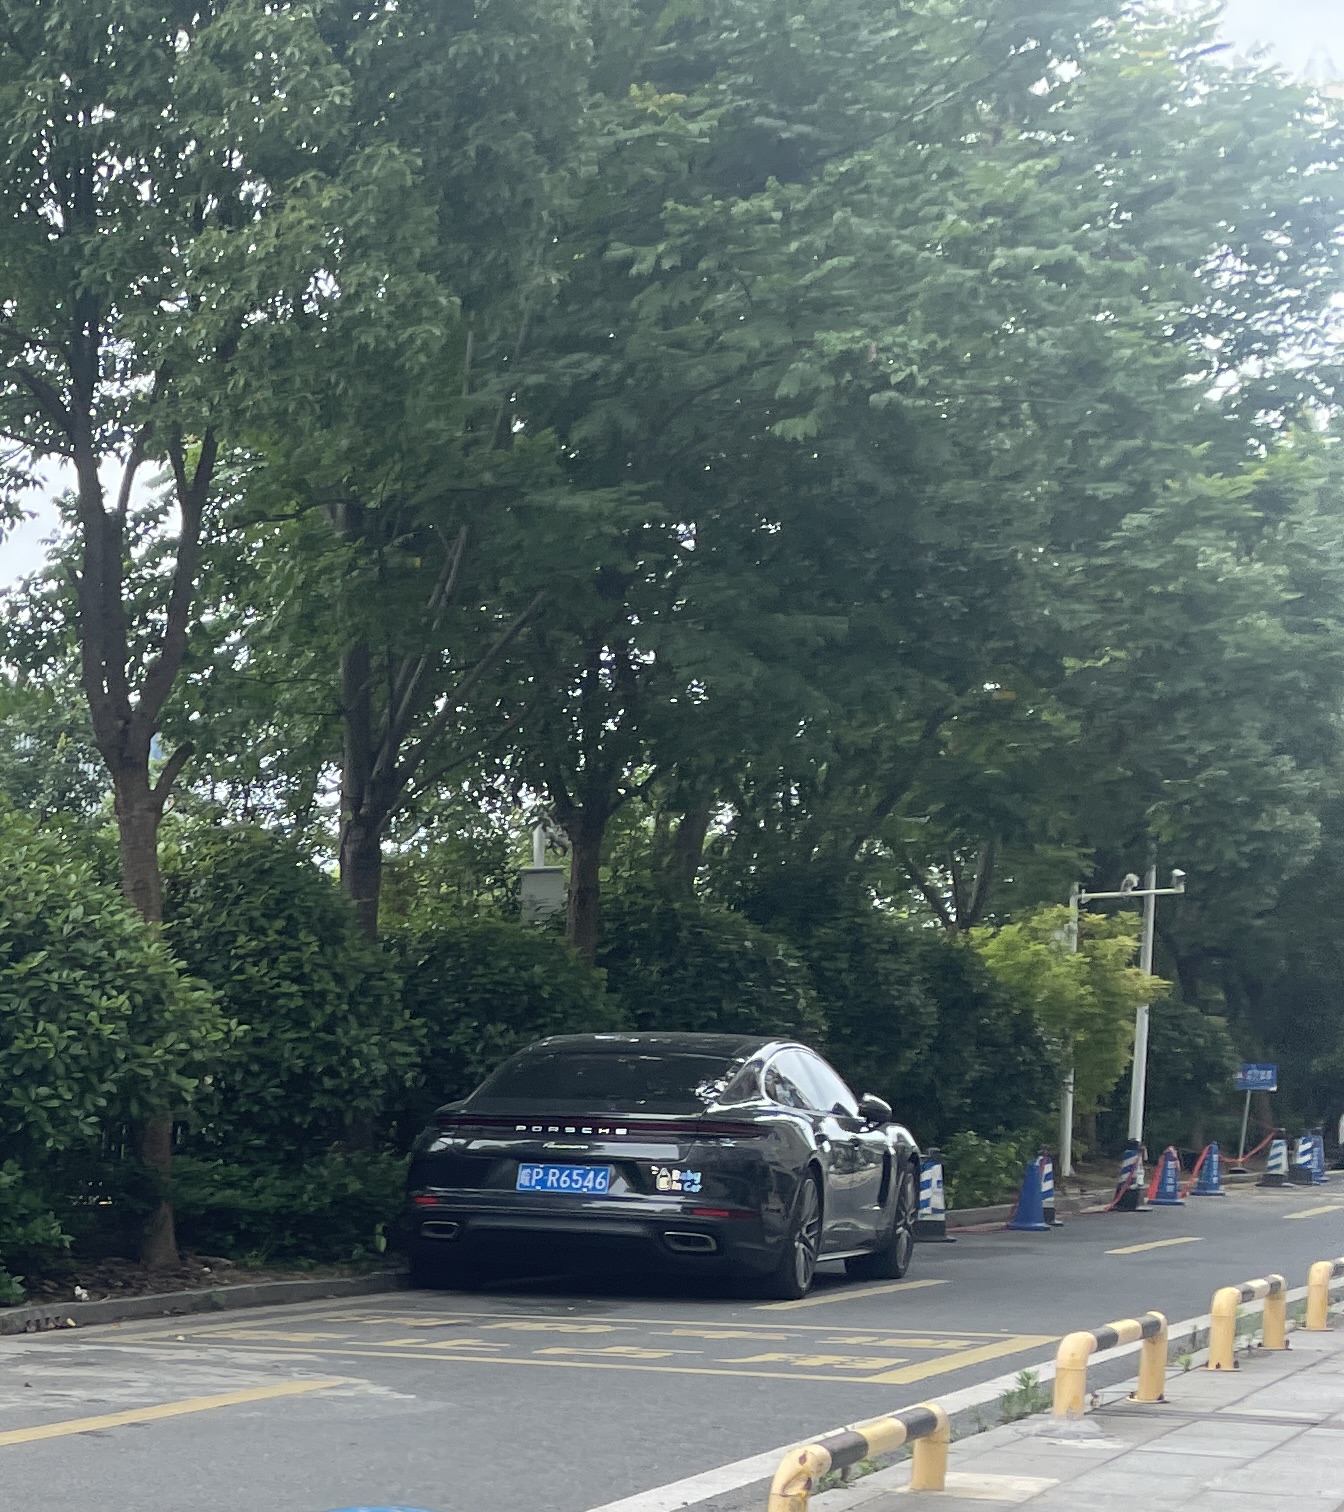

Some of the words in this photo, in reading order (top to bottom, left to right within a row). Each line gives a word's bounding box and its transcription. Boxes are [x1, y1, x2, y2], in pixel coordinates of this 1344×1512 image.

[515, 1125, 627, 1135] PORSCHE
[190, 1328, 912, 1370] 禁止占用
